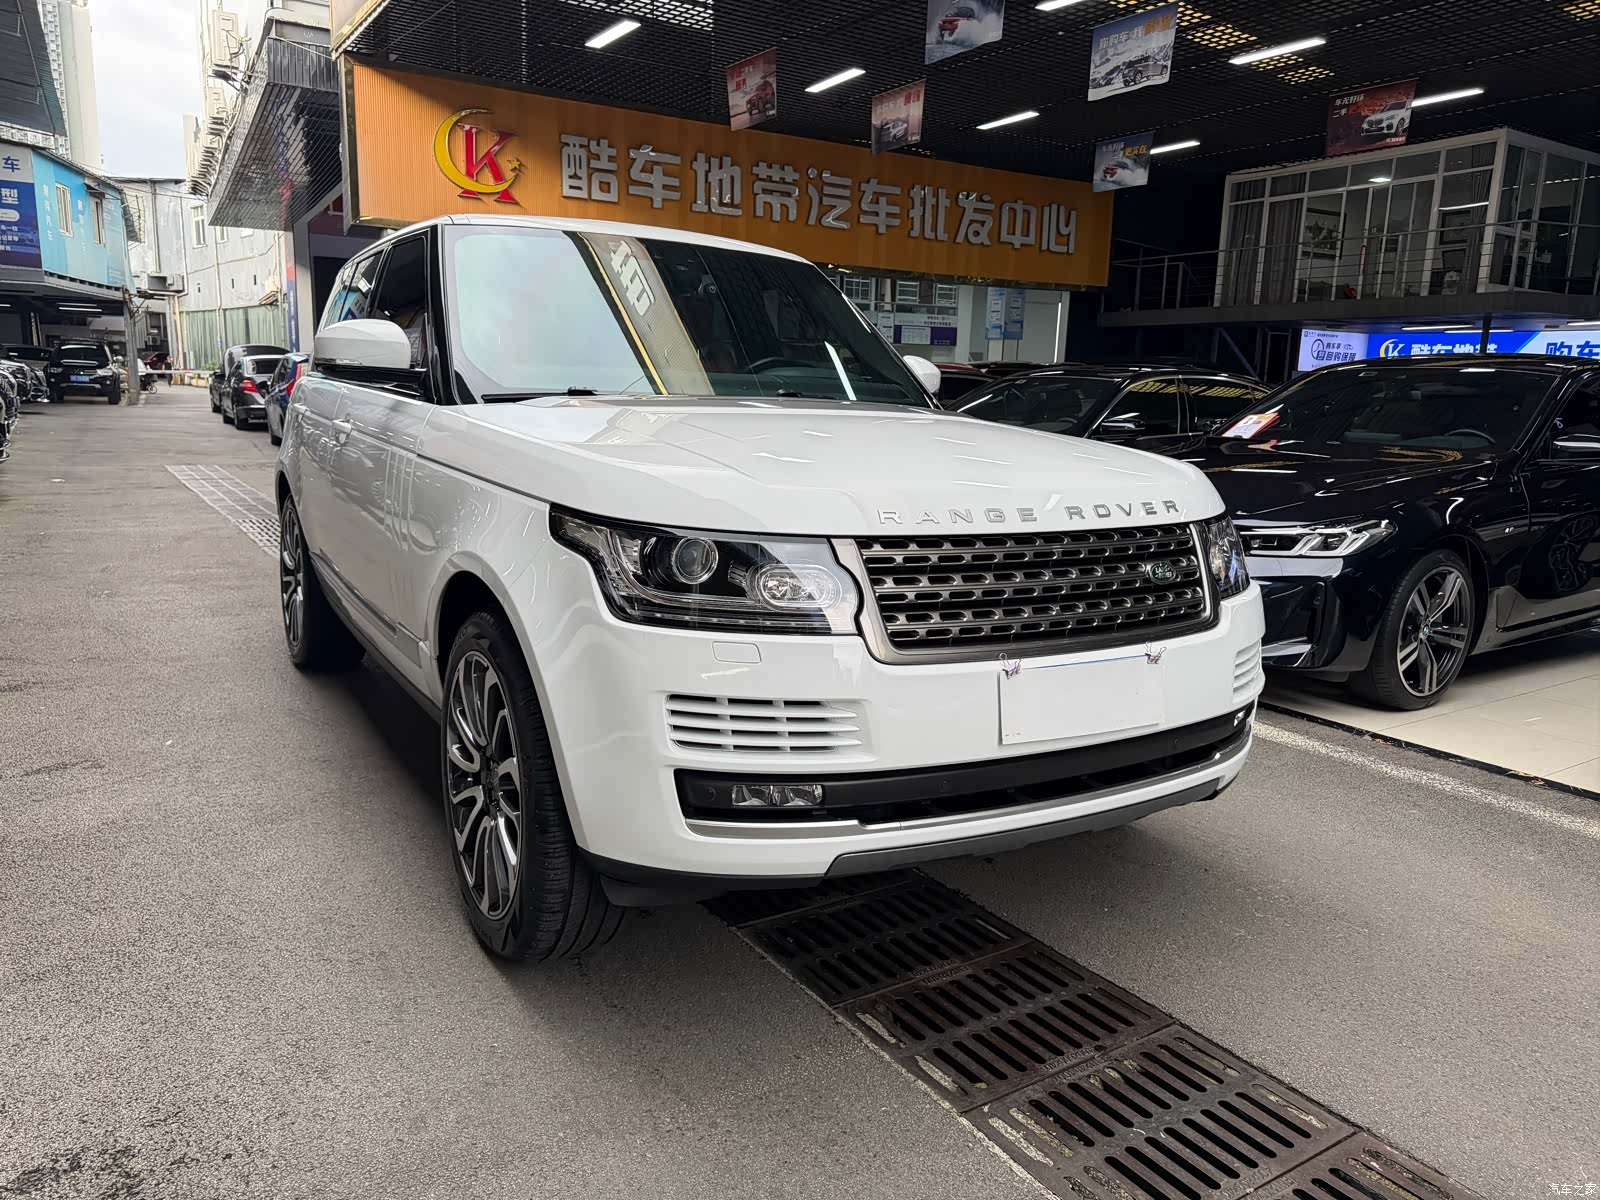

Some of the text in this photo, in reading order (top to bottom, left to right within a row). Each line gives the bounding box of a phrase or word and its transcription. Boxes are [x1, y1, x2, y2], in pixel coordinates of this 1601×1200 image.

[2, 155, 20, 172] 车
[560, 133, 1077, 255] 酷车地带汽车批发中心
[877, 499, 1180, 525] RANGE ROVER
